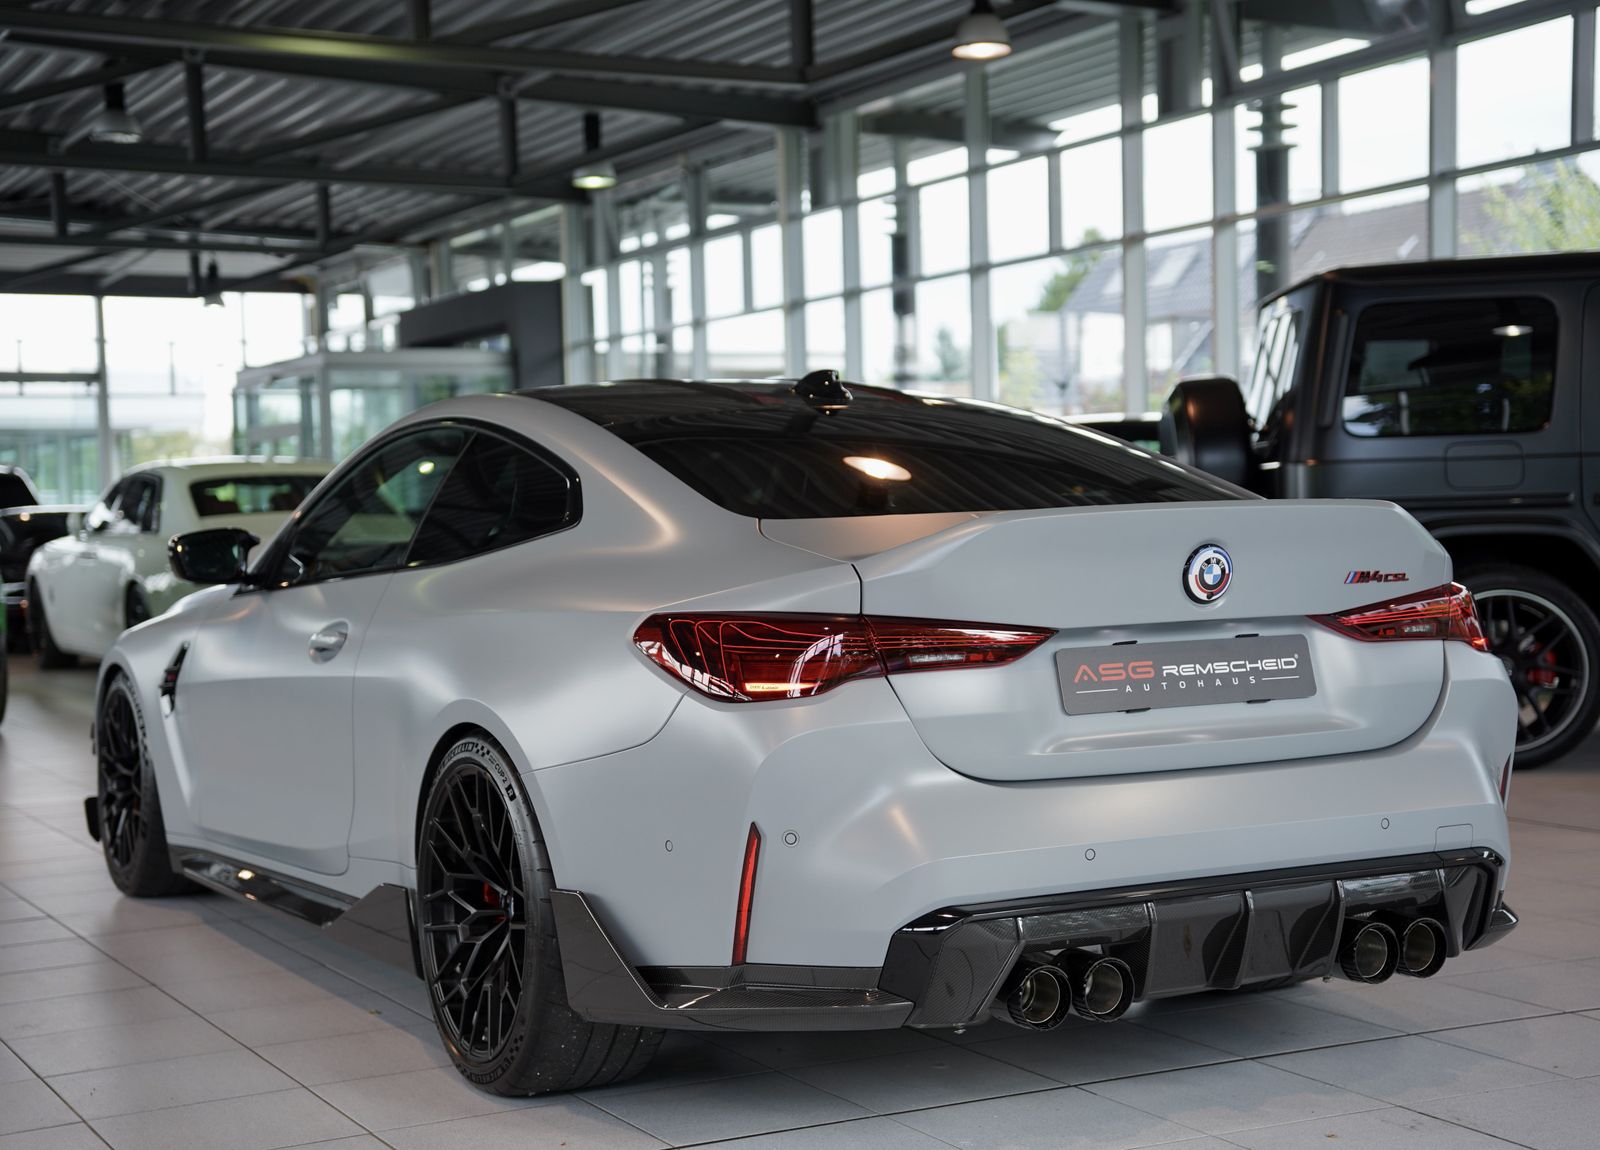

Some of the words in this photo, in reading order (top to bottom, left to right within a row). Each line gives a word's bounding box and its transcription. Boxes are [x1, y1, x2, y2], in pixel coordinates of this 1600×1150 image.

[1201, 557, 1225, 570] BMW
[1074, 661, 1155, 683] ASG
[1126, 676, 1256, 693] AUTOHAUS
